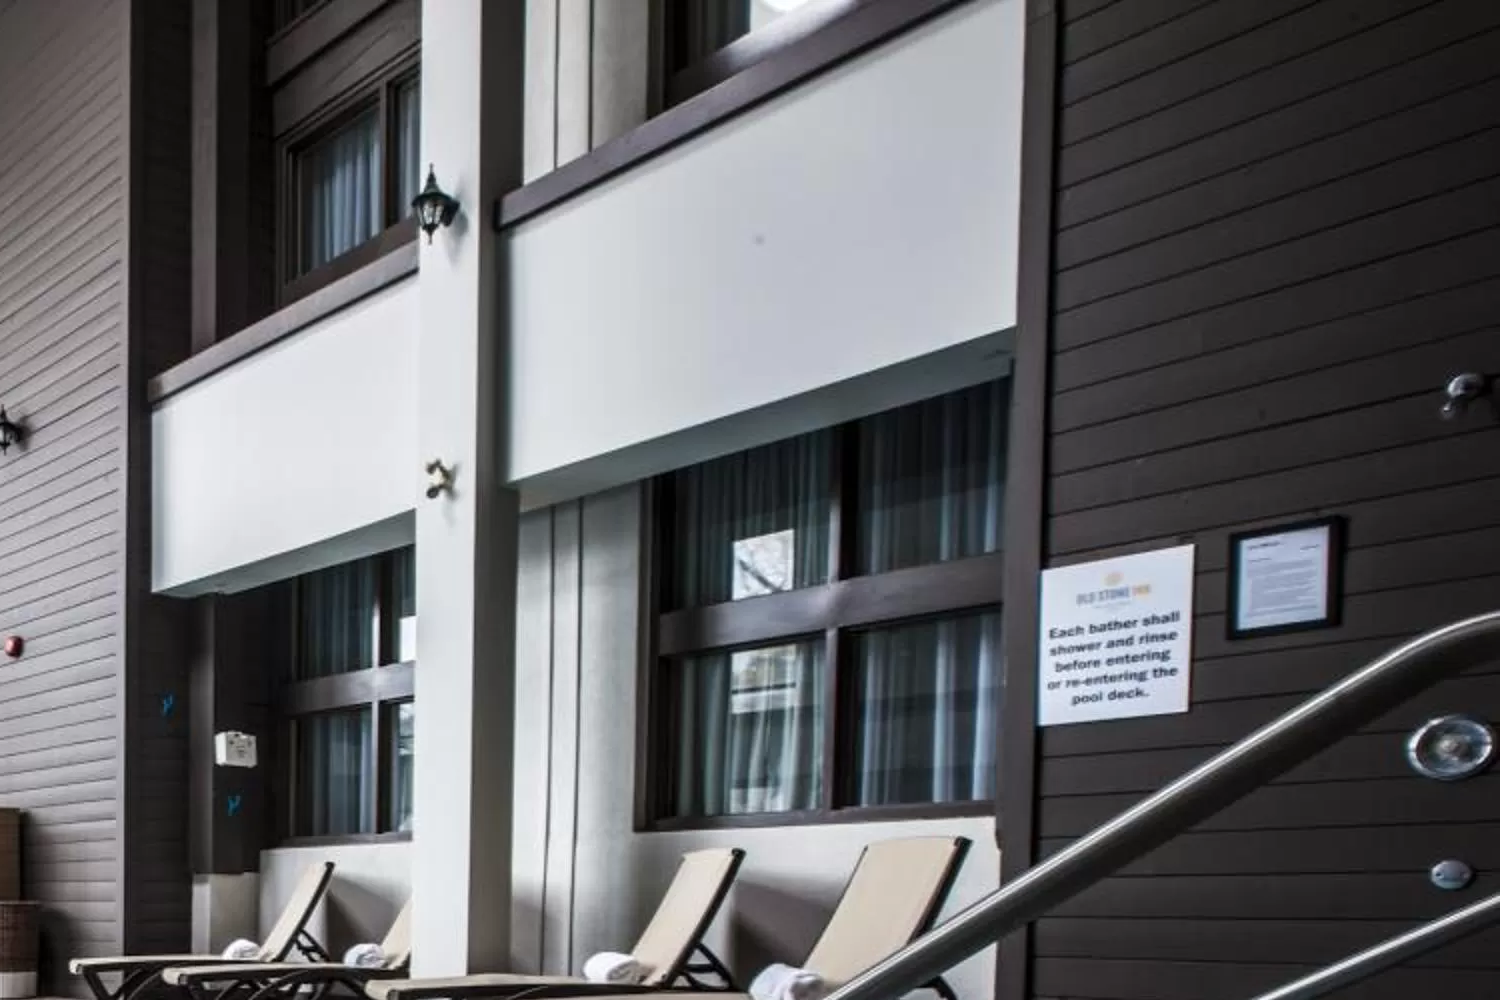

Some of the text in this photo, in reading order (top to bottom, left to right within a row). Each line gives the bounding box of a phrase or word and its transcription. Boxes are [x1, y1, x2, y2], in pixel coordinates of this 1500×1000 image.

[1049, 611, 1180, 639] Each bather shall
[1050, 632, 1178, 656] shower and rinse
[1055, 650, 1170, 672] before entering
[1047, 667, 1178, 690] or re-entering the
[1071, 688, 1150, 706] pool deck.
